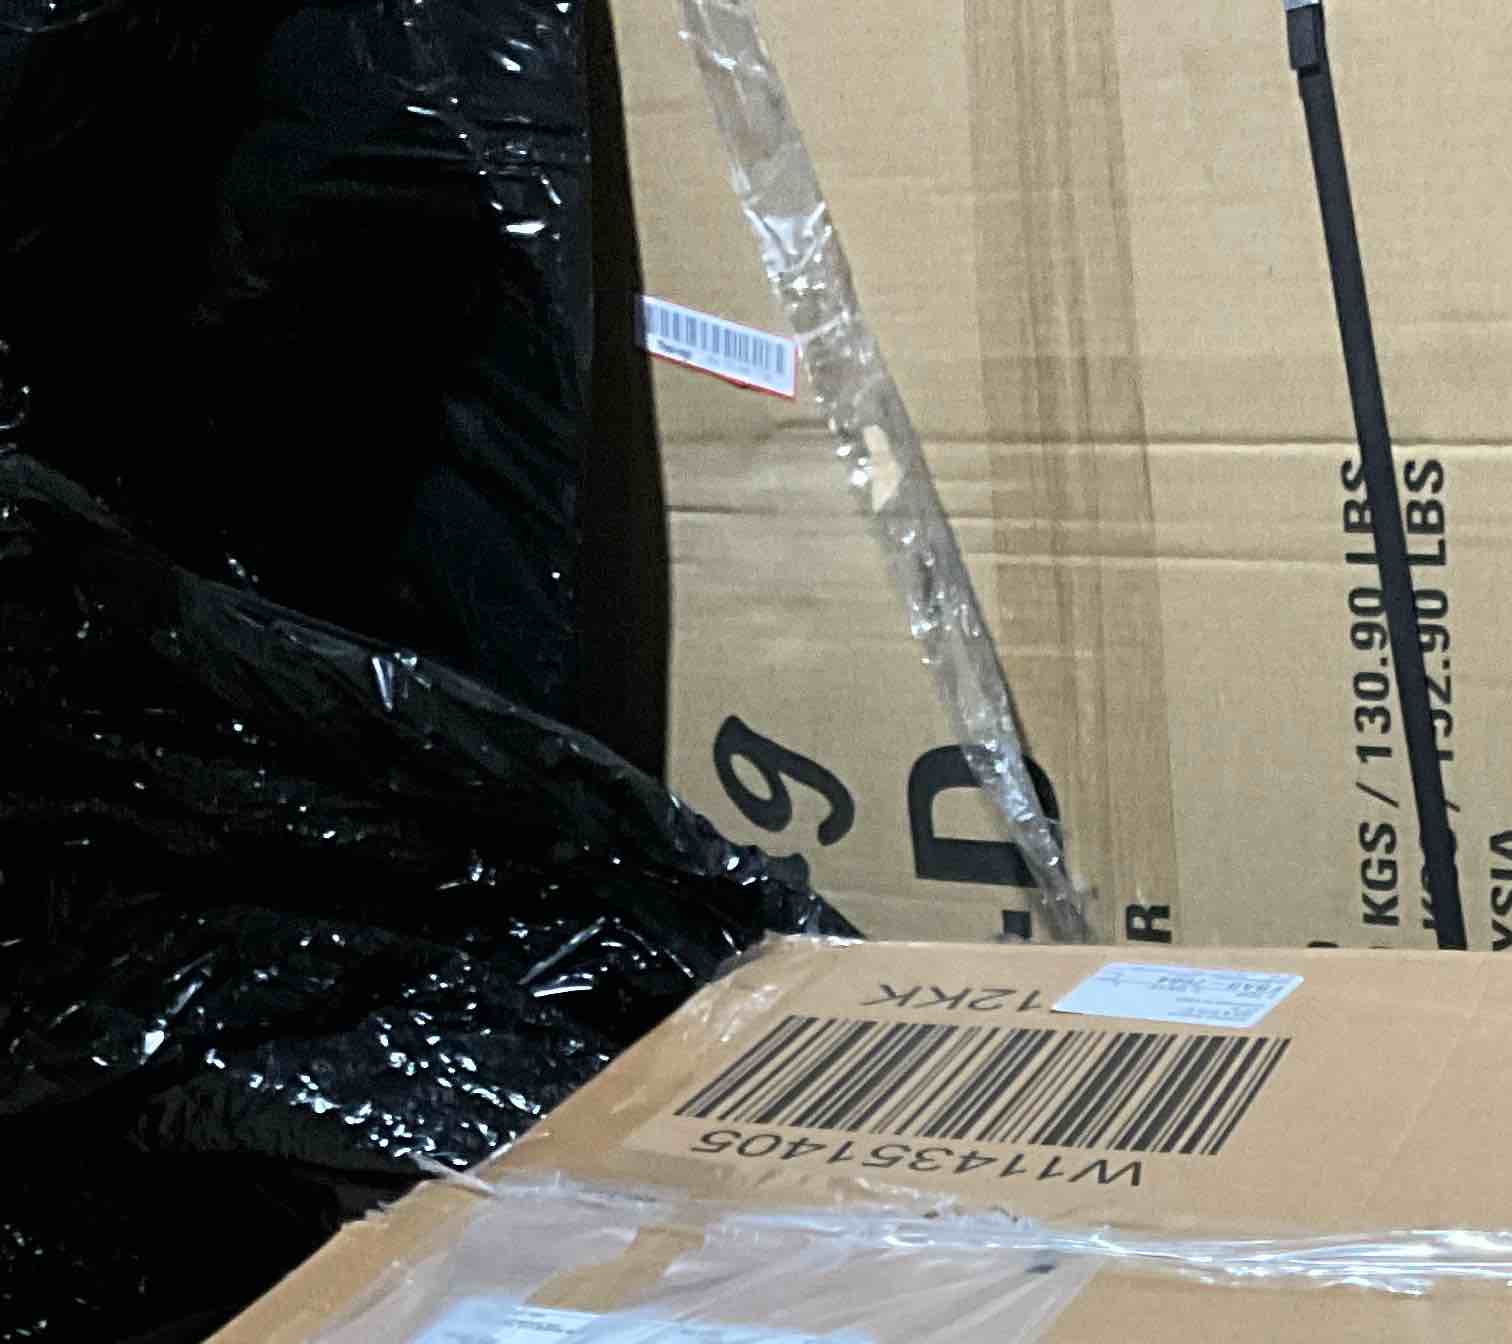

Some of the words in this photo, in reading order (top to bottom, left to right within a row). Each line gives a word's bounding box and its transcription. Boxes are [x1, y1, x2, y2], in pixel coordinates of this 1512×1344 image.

[1403, 459, 1446, 566] LBS
[1349, 587, 1392, 764] 130.90
[1359, 822, 1399, 927] KGS
[691, 1129, 1144, 1187] W114351405
